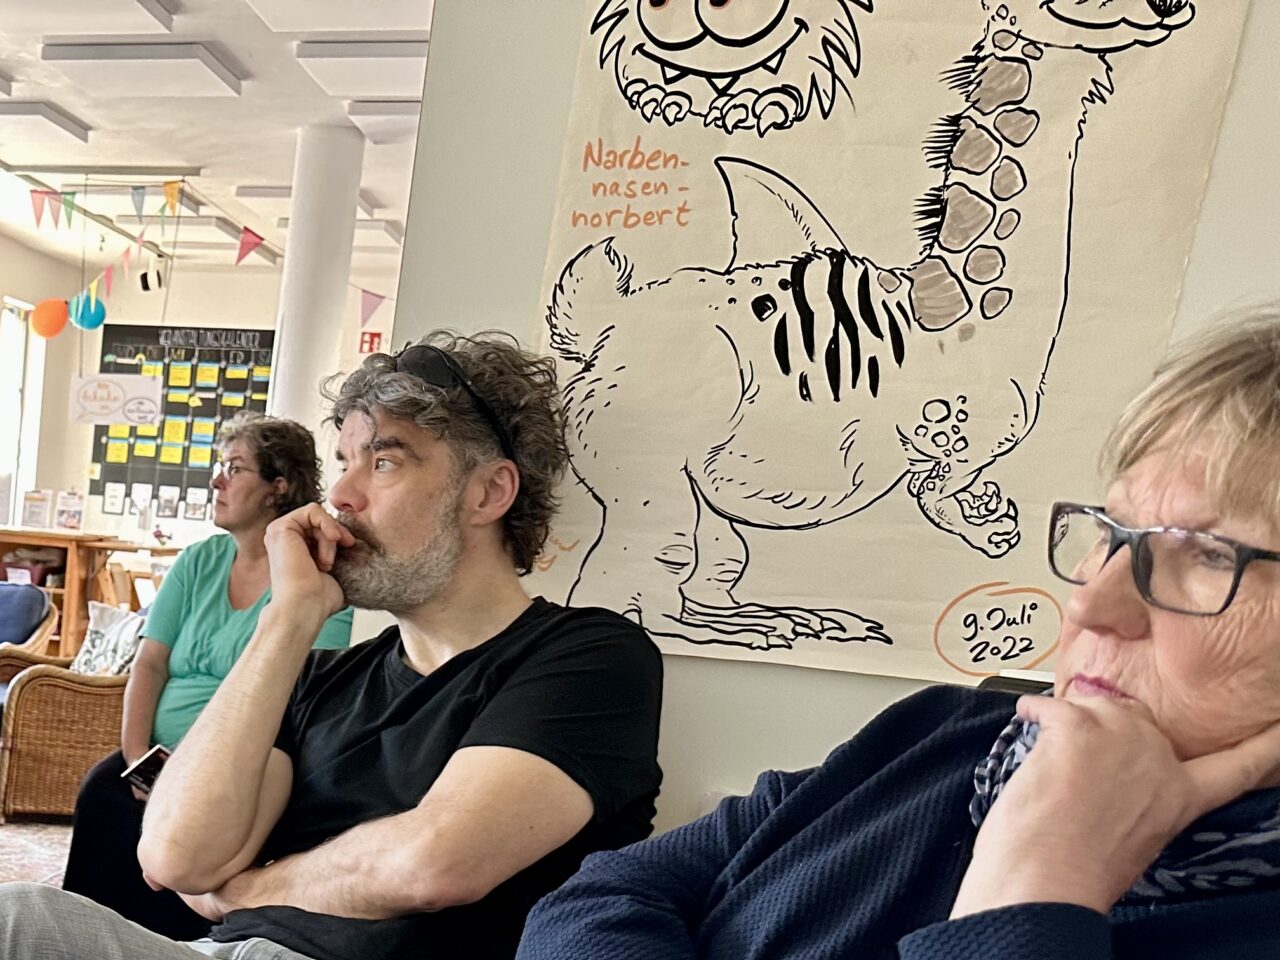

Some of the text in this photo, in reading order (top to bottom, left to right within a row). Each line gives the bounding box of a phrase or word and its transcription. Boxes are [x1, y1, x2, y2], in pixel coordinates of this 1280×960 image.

[582, 135, 690, 173] Narben-
[571, 200, 691, 229] norbert
[968, 635, 1035, 663] 2022
